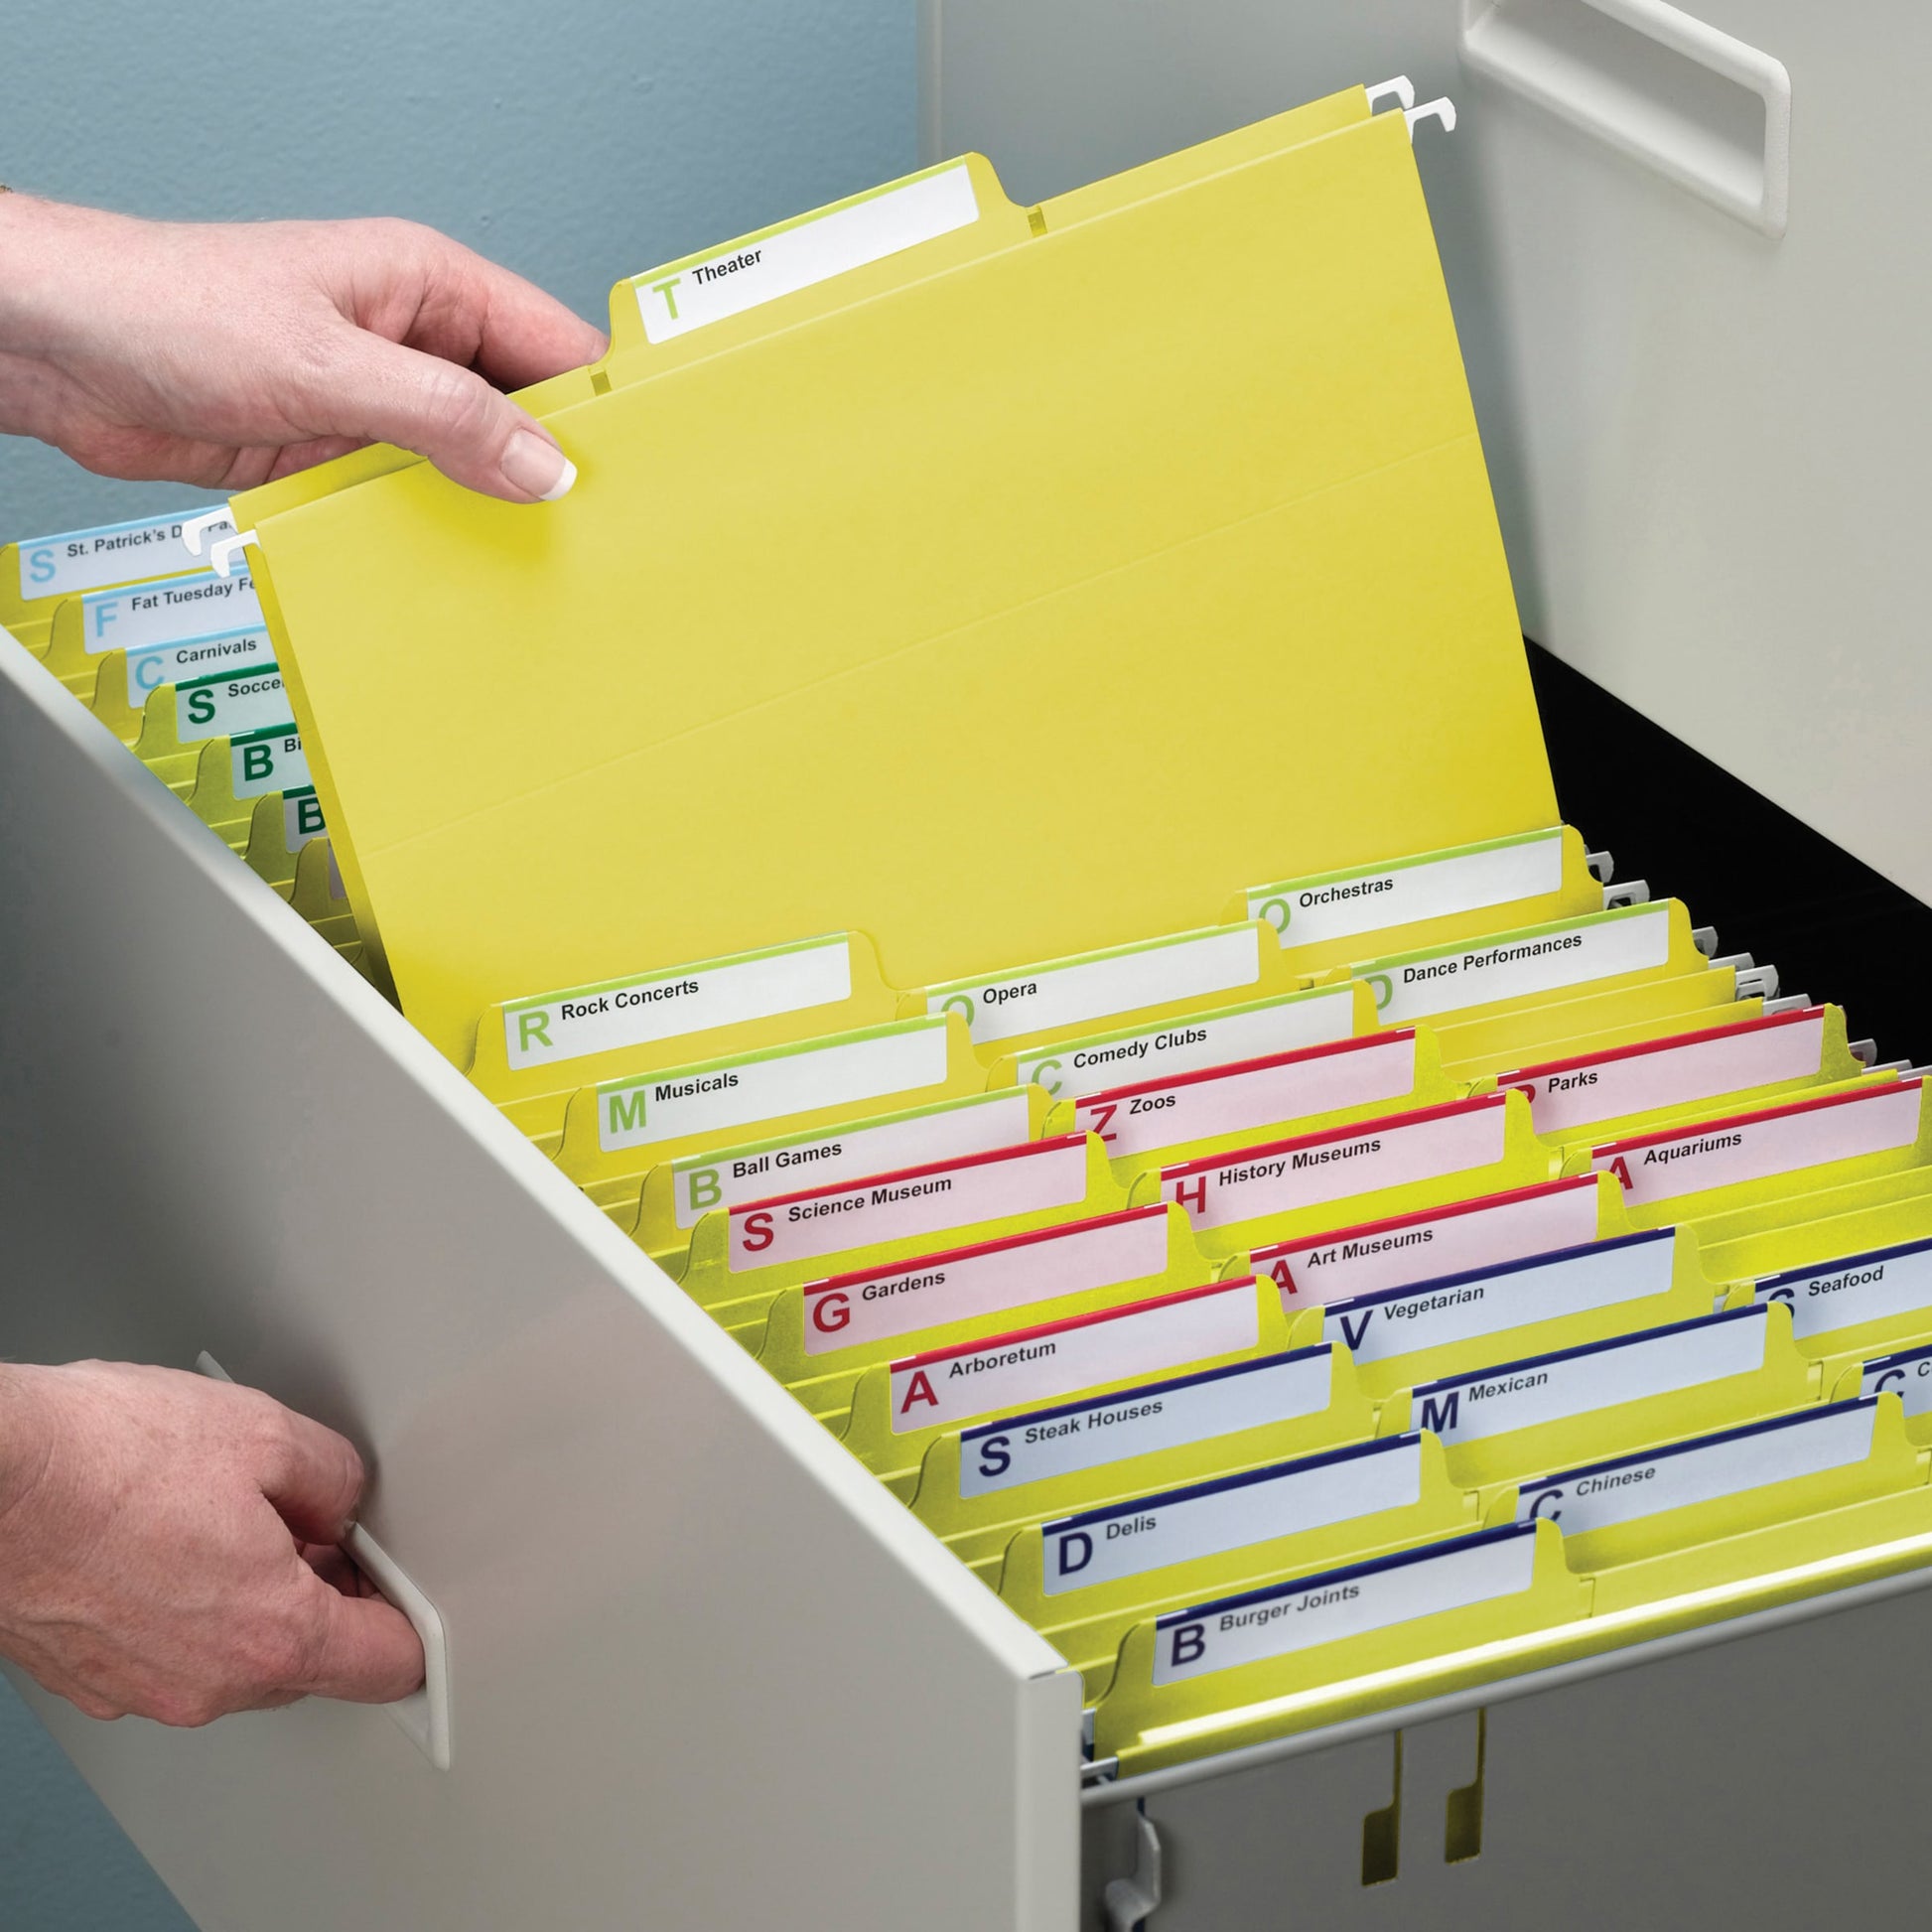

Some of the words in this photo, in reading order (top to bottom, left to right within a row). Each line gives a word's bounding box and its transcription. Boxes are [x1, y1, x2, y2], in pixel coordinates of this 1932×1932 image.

[692, 249, 761, 285] Theater
[652, 278, 681, 320] T
[67, 540, 88, 557] St.
[94, 528, 166, 552] Patrick's
[29, 550, 57, 584] S
[131, 595, 158, 611] Fat
[164, 581, 233, 606] Tuesday
[96, 602, 118, 637] F
[176, 638, 257, 664] Carnivals
[135, 656, 164, 690] C
[188, 690, 215, 724] S
[244, 745, 274, 781] B
[1299, 876, 1394, 908] Orchestras
[1403, 958, 1457, 984] Dance
[1462, 933, 1583, 971] Performances
[561, 998, 610, 1020] Rock
[615, 979, 699, 1008] Concerts
[983, 983, 1036, 1005] Opera
[518, 1010, 553, 1051] R
[1073, 1040, 1149, 1069] Comedy
[1155, 1027, 1207, 1050] Clubs
[655, 1073, 739, 1102] Musicals
[1032, 1059, 1062, 1095] C
[1548, 1070, 1598, 1093] Parks
[609, 1090, 646, 1134] M
[1130, 1093, 1176, 1115] Zoos
[1090, 1104, 1117, 1142] Z
[733, 1157, 769, 1178] Ball
[775, 1143, 842, 1169] Games
[1219, 1159, 1286, 1186] History
[1292, 1139, 1381, 1171] Museums
[1644, 1133, 1742, 1166] Aquariums
[689, 1169, 722, 1210] B
[1608, 1157, 1633, 1190] A
[788, 1195, 865, 1222] Science
[871, 1177, 952, 1205] Museum
[1175, 1176, 1206, 1214] H
[742, 1212, 774, 1252] S
[1307, 1248, 1336, 1269] Art
[1342, 1228, 1433, 1260] Museums
[862, 1271, 945, 1301] Gardens
[1267, 1259, 1299, 1295] A
[1808, 1266, 1883, 1297] Seafood
[812, 1293, 850, 1333] G
[1384, 1287, 1484, 1321] Vegetarian
[1339, 1310, 1373, 1351] V
[949, 1341, 1056, 1378] Arboretum
[900, 1370, 939, 1414] A
[1468, 1372, 1548, 1403] Mexican
[1025, 1417, 1081, 1444] Steak
[1087, 1400, 1164, 1429] Houses
[1421, 1391, 1459, 1434] M
[978, 1436, 1012, 1478] S
[1577, 1465, 1656, 1496] Chinese
[1106, 1514, 1157, 1540] Delis
[1057, 1531, 1093, 1576] D
[1219, 1599, 1291, 1632] Burger
[1296, 1584, 1360, 1611] Joints
[1171, 1623, 1206, 1667] B
